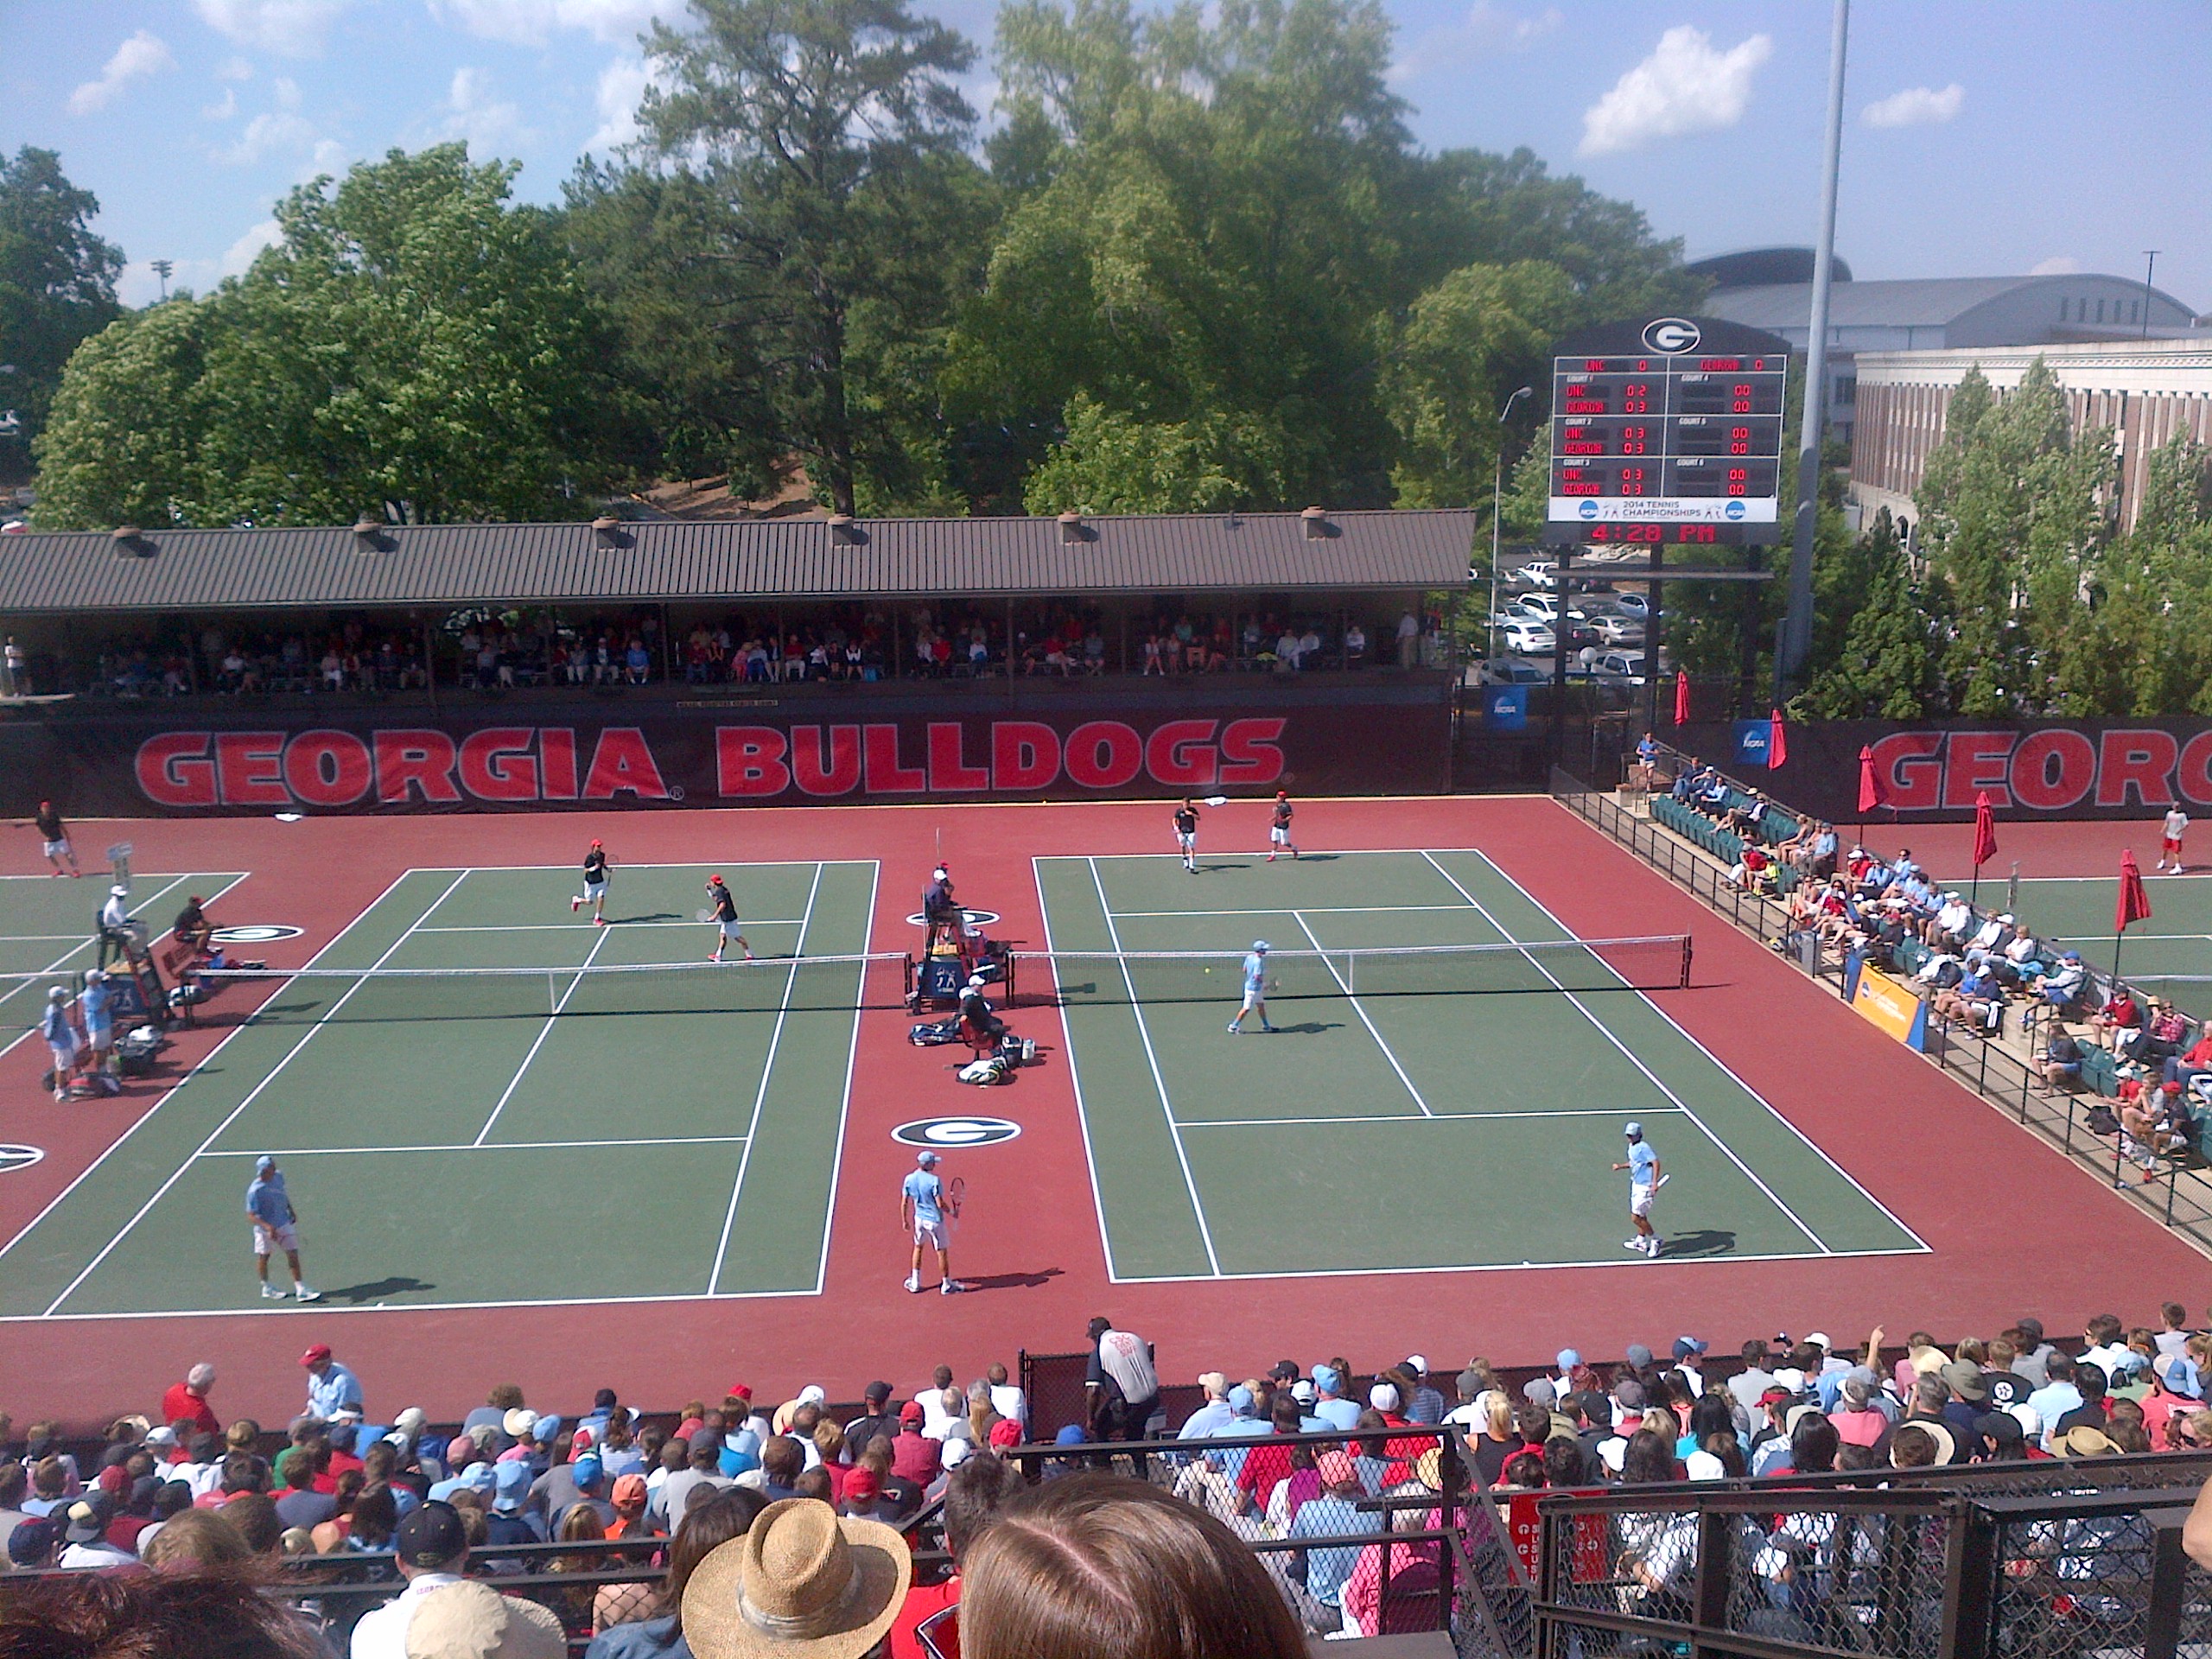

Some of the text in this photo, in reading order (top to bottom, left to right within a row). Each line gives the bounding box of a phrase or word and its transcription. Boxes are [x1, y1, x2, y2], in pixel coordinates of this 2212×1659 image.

[1586, 359, 1647, 372] UNC 0
[1755, 359, 1763, 371] 0
[1567, 385, 1586, 397] UNC
[1565, 427, 1583, 439] UNC
[1592, 524, 1715, 543] 4:28 PM
[135, 718, 1287, 806] GEORGIA BULLDOGS
